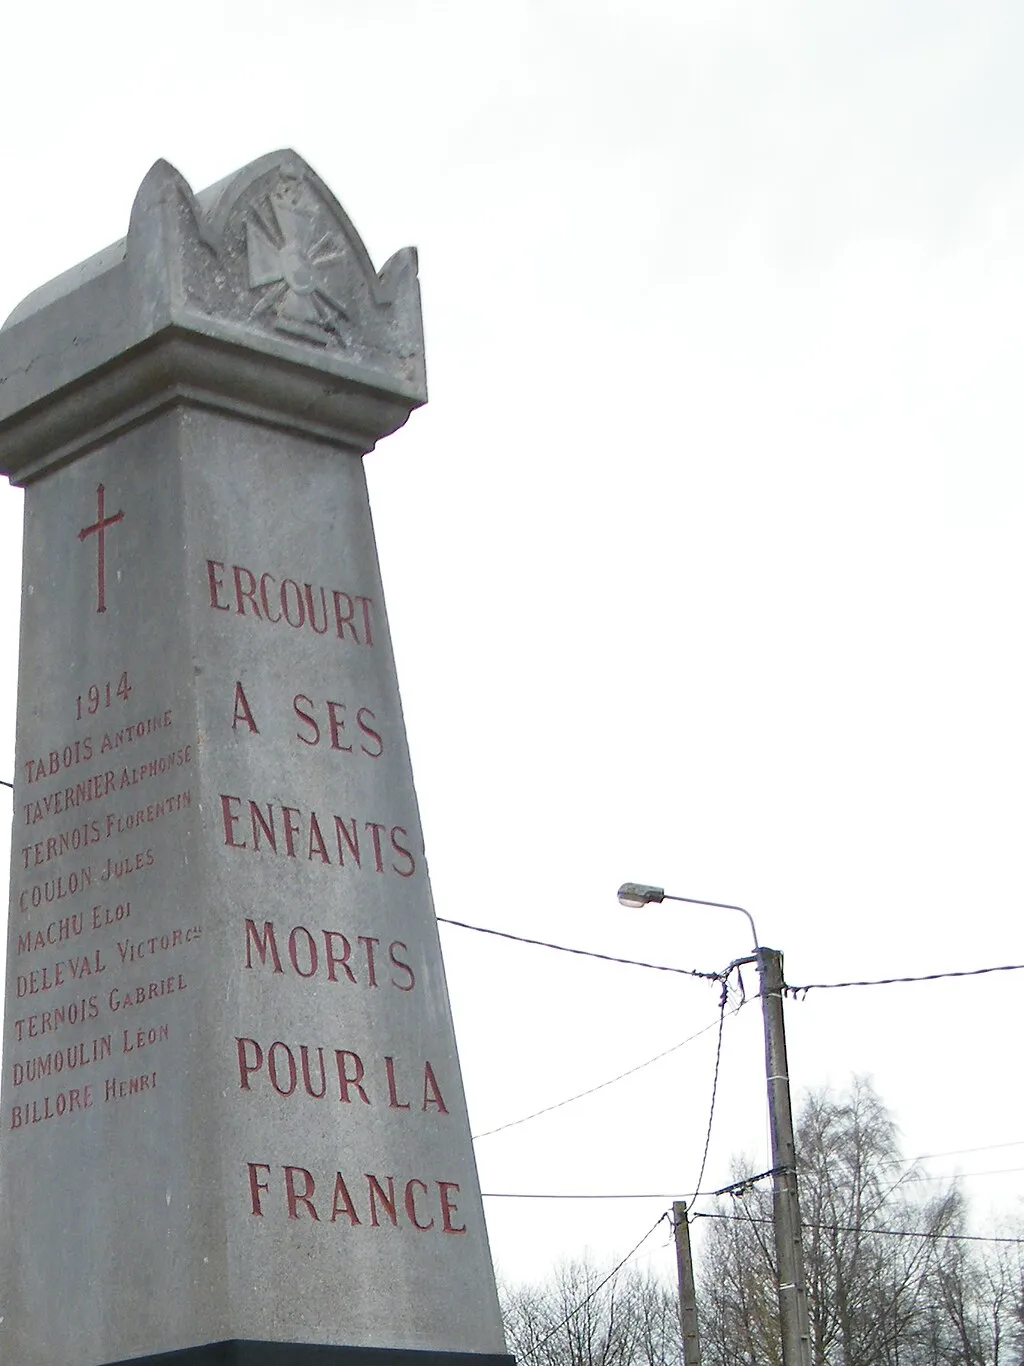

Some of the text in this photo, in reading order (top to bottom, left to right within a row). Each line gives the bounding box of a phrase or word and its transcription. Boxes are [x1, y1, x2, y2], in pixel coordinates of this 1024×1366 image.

[206, 559, 375, 648] ERCOURT
[76, 671, 132, 721] 1914
[232, 681, 384, 759] A SES
[25, 709, 173, 784] TABOIS ANTOINE
[24, 745, 192, 825] TAVERNIER ALPHONSE
[22, 790, 192, 869] TERNOIS FLORENTIN
[219, 794, 416, 877] ENFANTS
[19, 849, 155, 913] COULON JULES
[16, 949, 106, 999] DELEVAL
[116, 928, 183, 964] VICTOR
[17, 902, 131, 956] MACHU ELOI
[244, 918, 416, 991] MORTS
[14, 974, 188, 1042] TERNOIS GABRIEL
[13, 1034, 112, 1087] DUMOULIN
[235, 1036, 450, 1114] POUR LA
[10, 1072, 157, 1130] BILLORE HENRI
[247, 1162, 466, 1234] FRANCE
